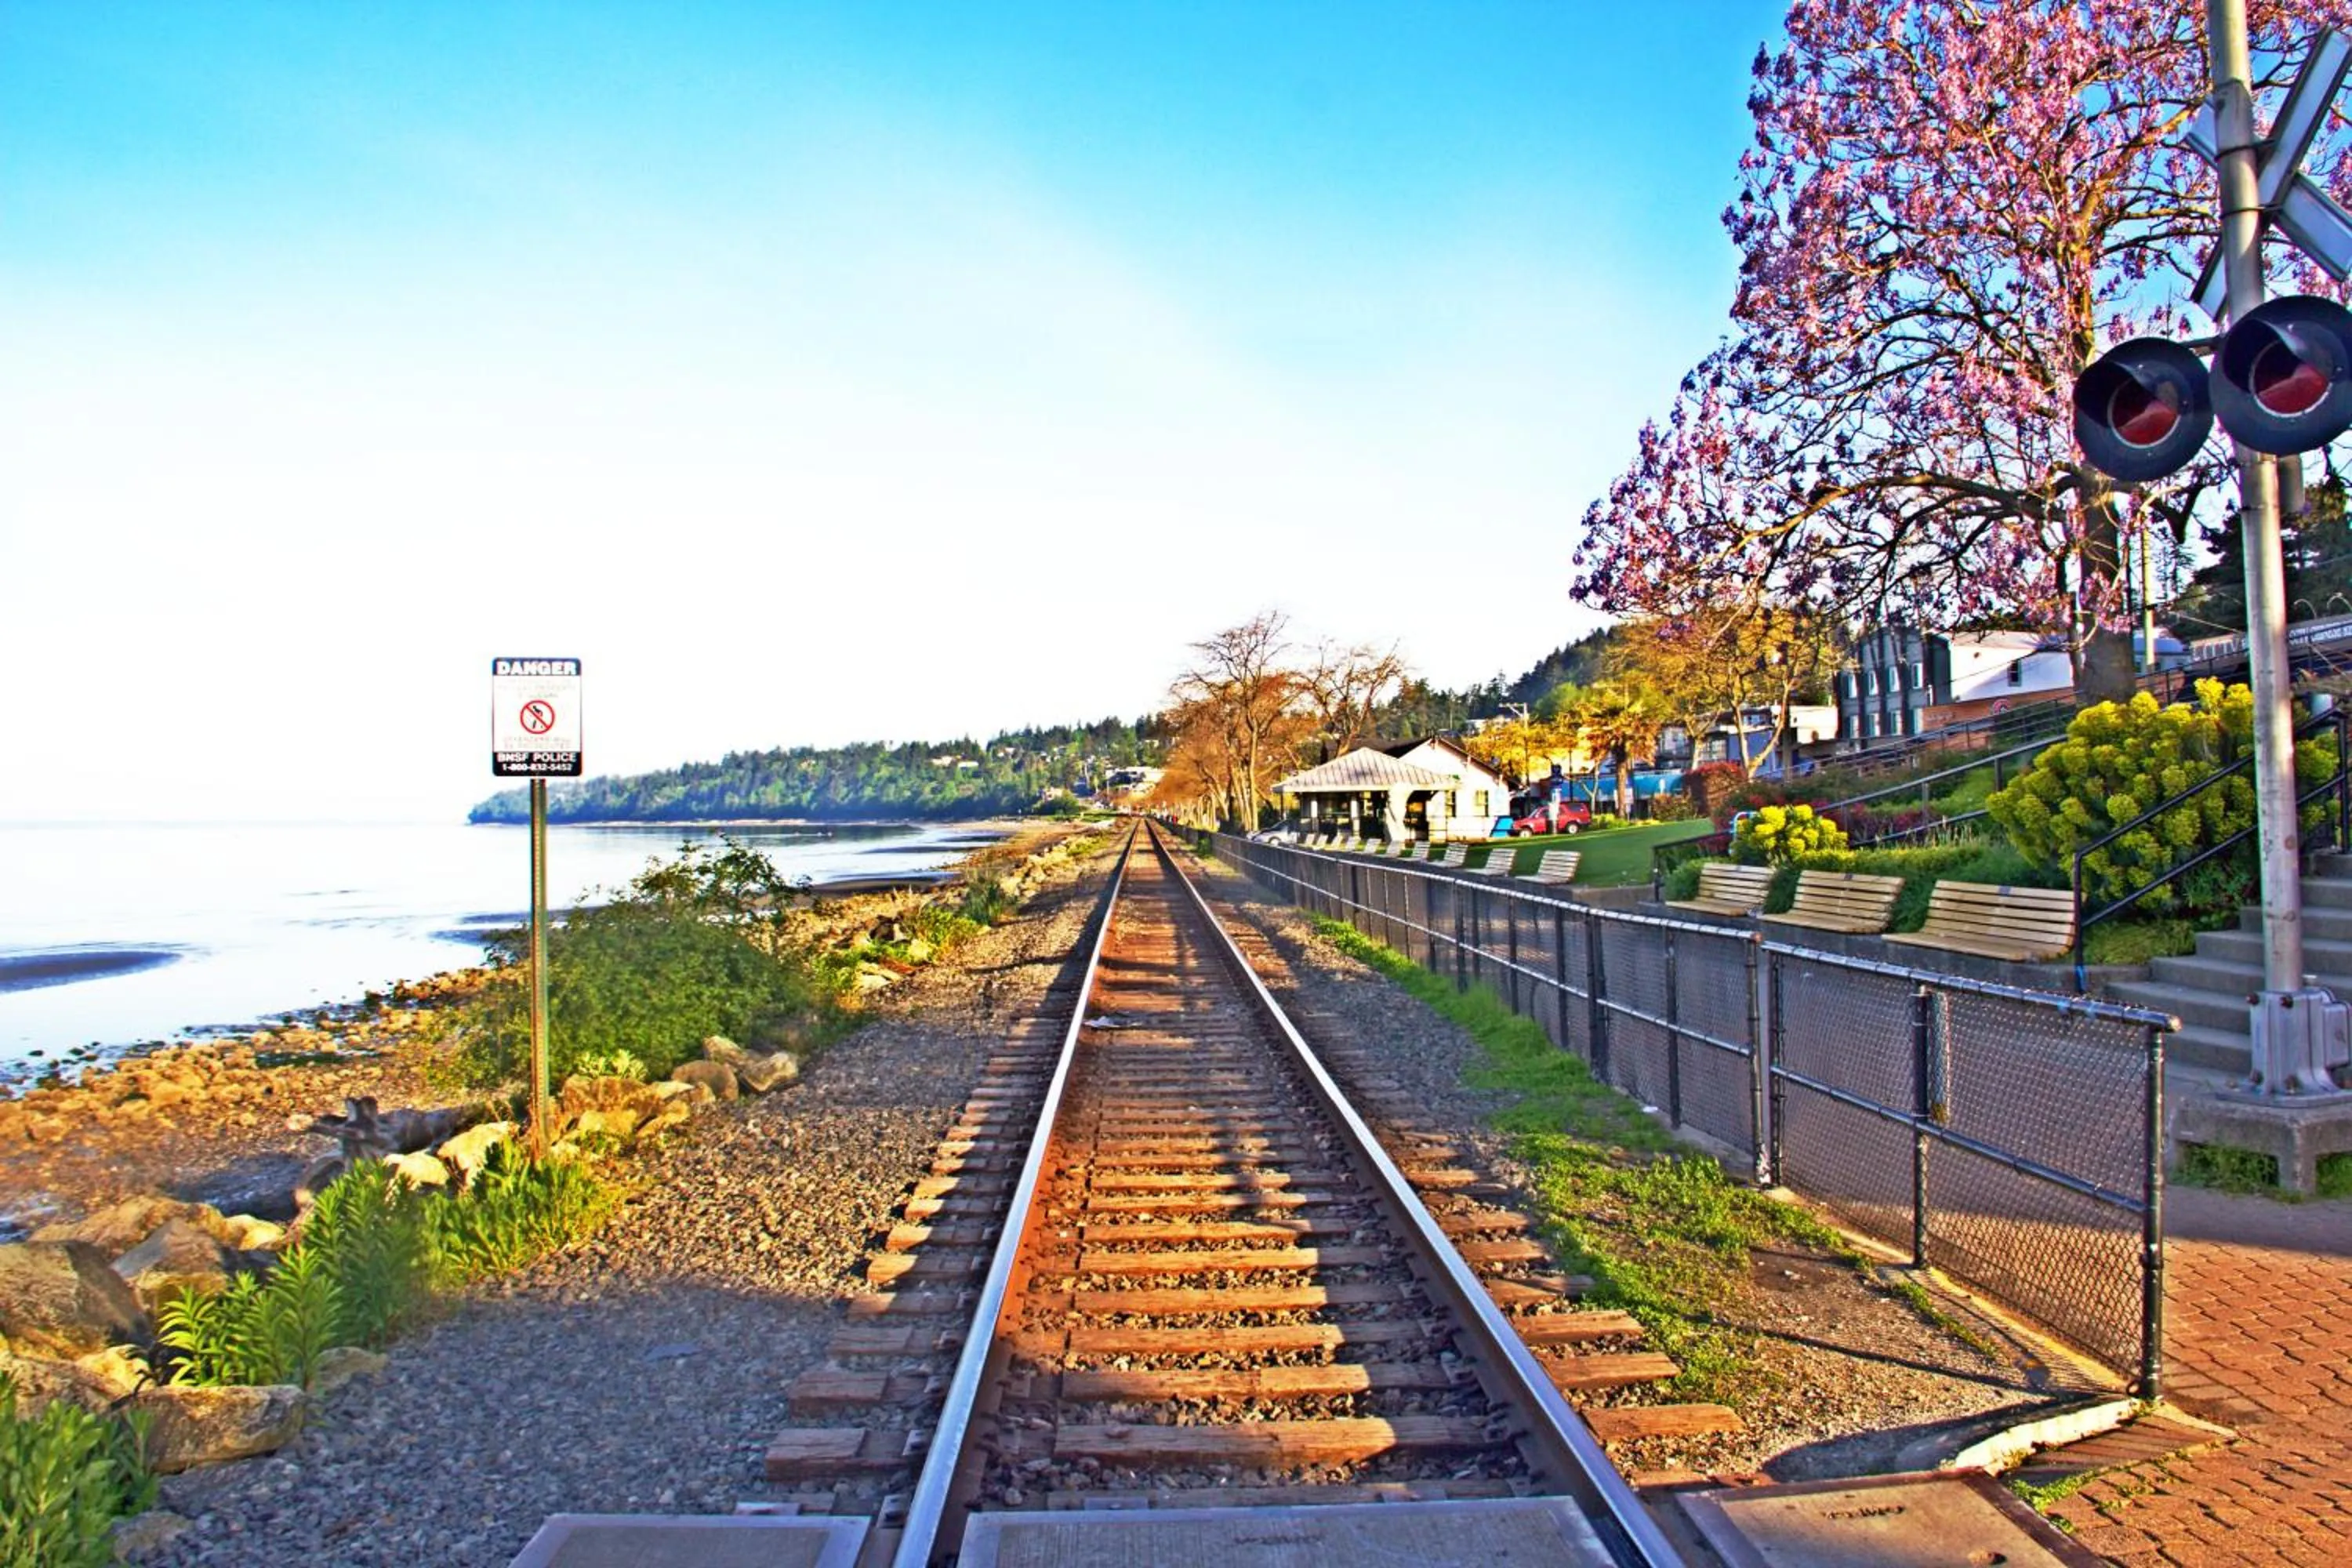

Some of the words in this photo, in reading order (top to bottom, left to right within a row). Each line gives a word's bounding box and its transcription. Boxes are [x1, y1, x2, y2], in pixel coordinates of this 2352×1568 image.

[496, 661, 576, 675] DANGER
[497, 753, 529, 762] BNSF
[533, 752, 576, 762] POLICE
